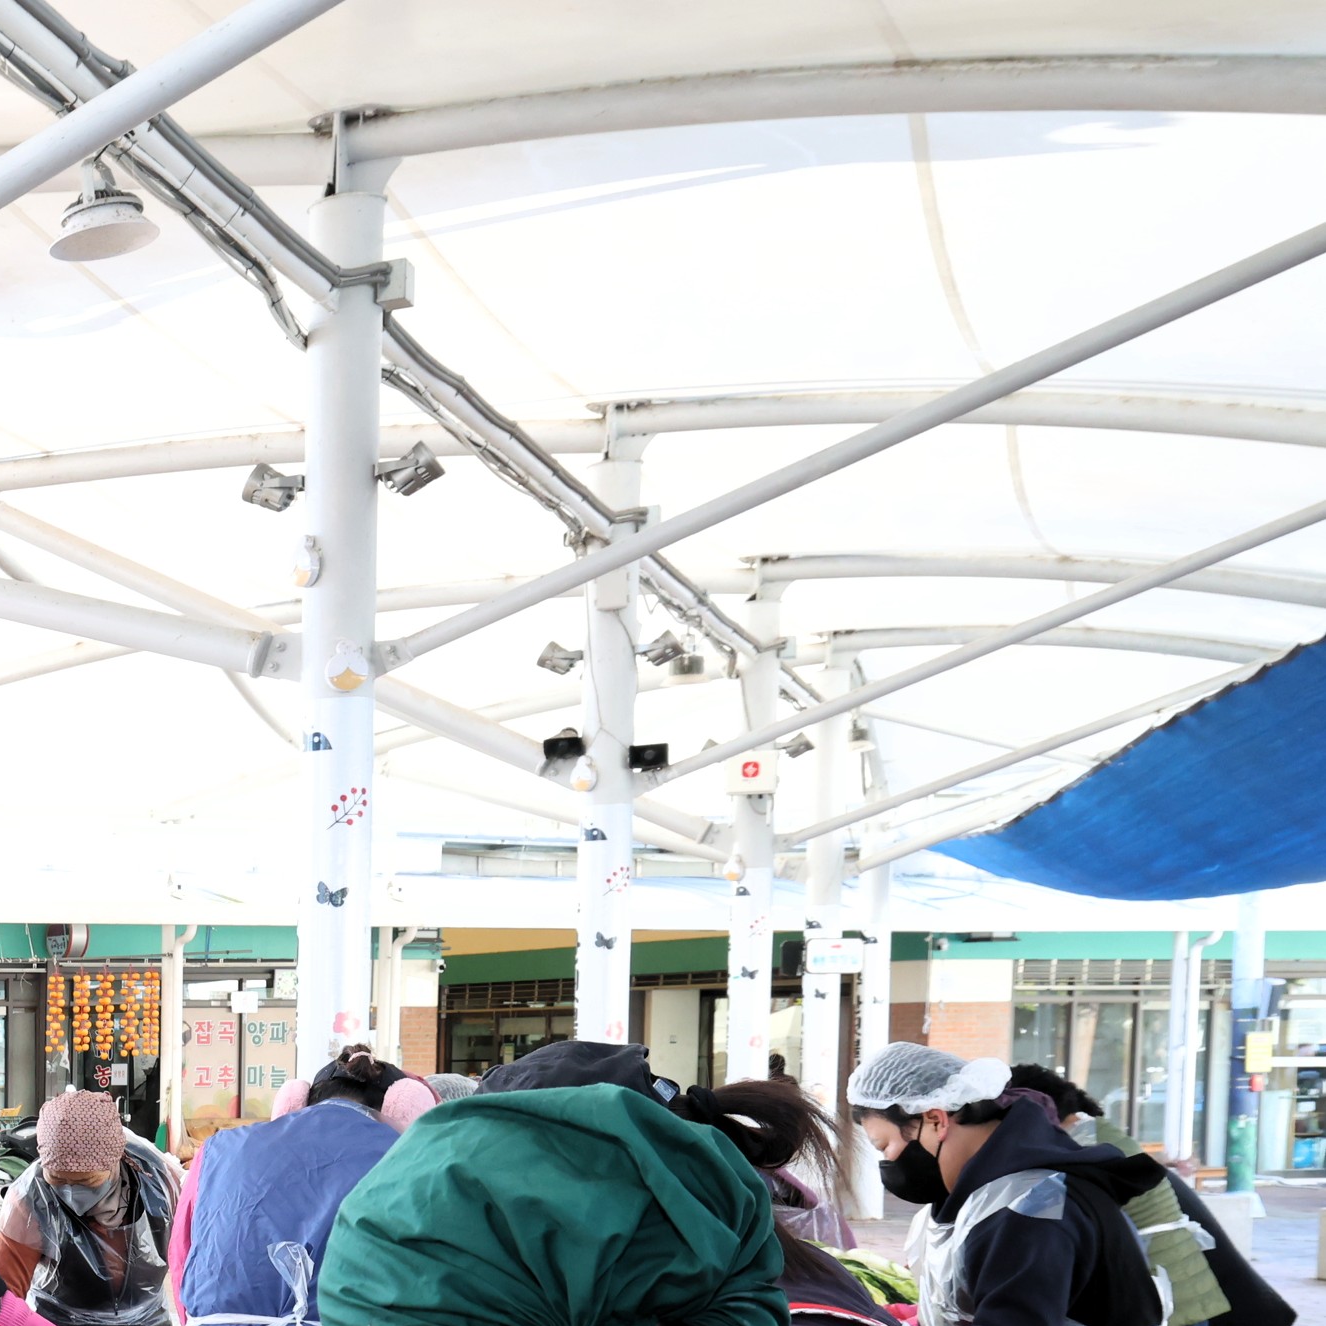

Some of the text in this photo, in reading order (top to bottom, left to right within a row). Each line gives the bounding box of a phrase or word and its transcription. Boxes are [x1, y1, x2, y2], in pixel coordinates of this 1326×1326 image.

[195, 1021, 288, 1045] 잡곡 양파
[194, 1065, 287, 1089] 고추 마늘
